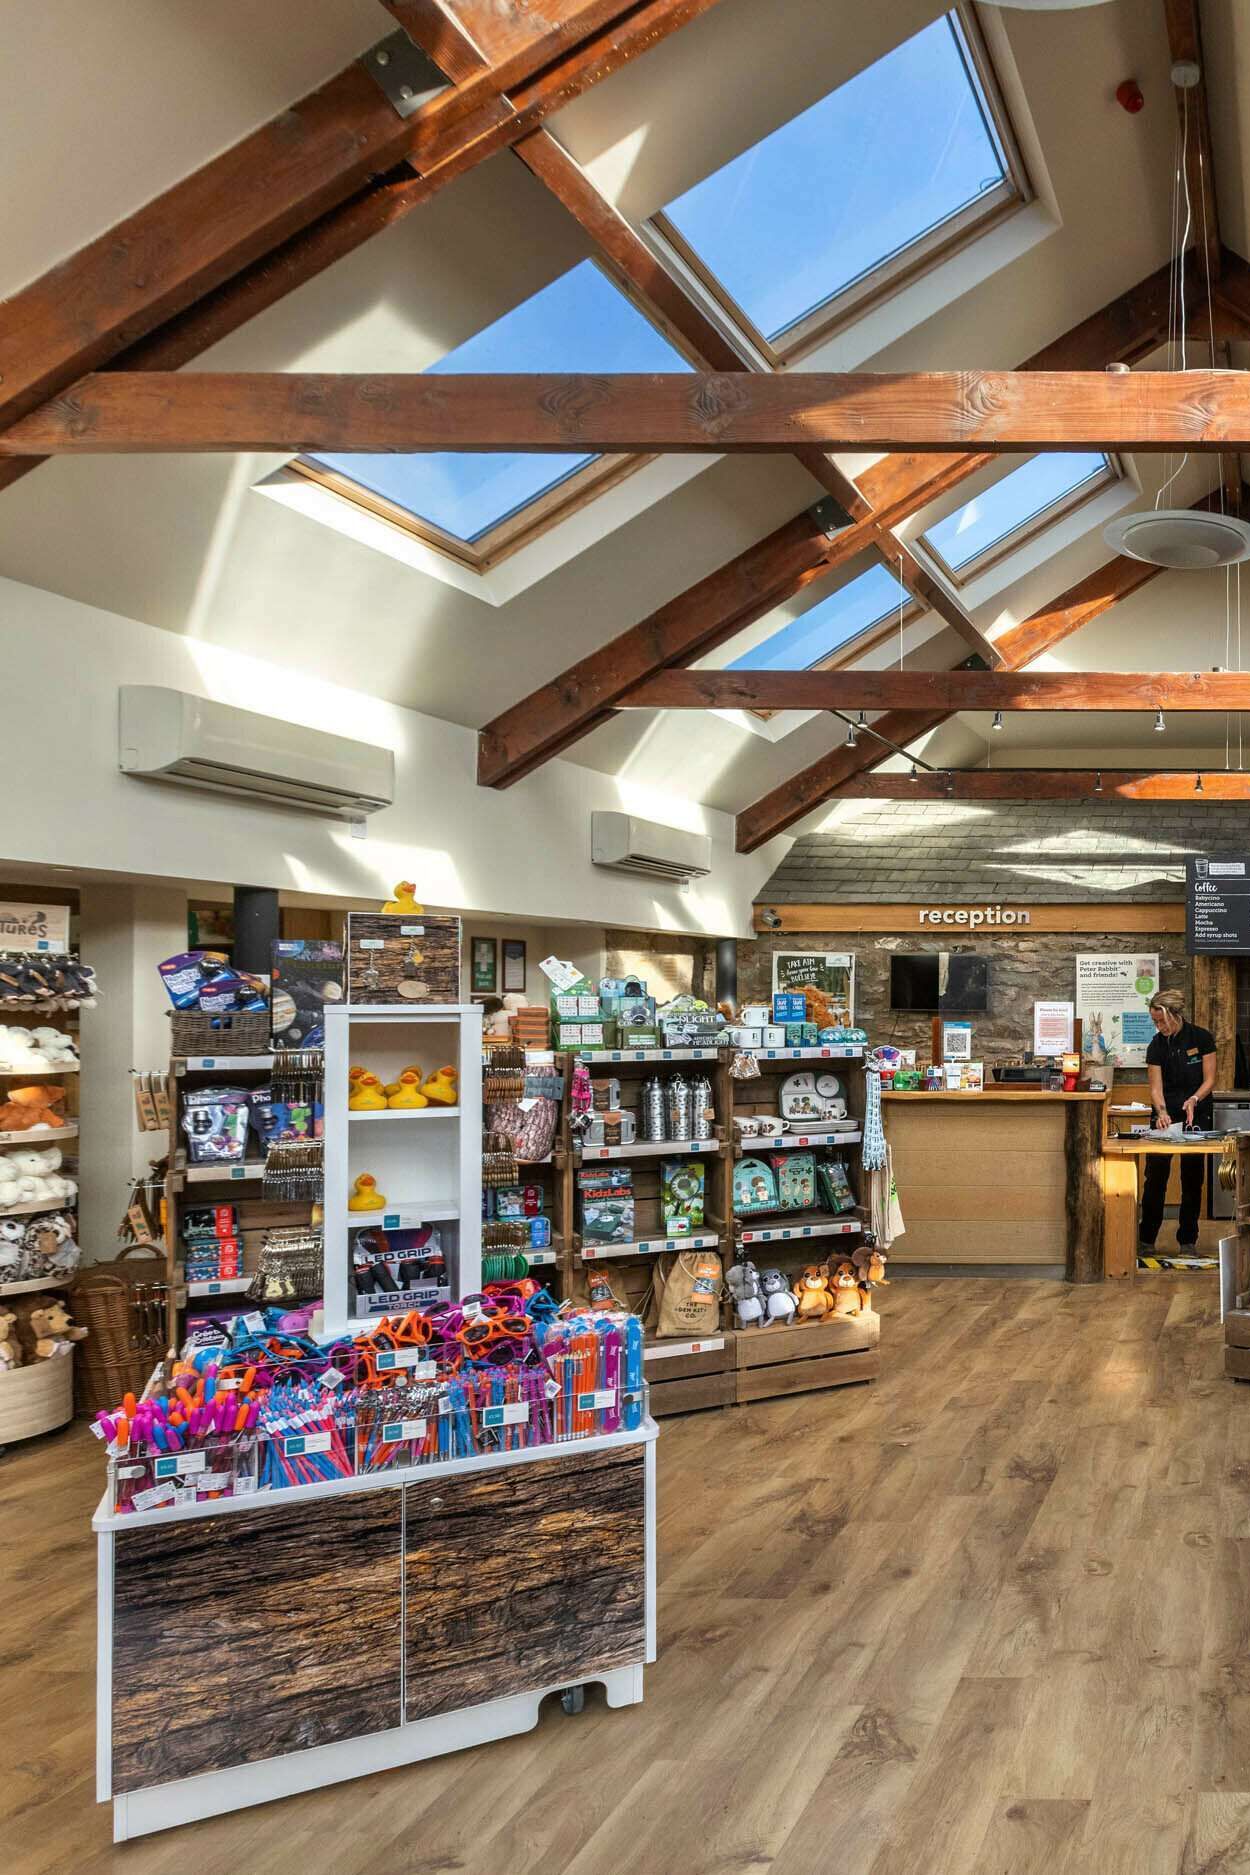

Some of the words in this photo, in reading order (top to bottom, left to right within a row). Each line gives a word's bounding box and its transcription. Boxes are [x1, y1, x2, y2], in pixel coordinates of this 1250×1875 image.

[1194, 881, 1218, 893] Coffee
[919, 905, 1031, 929] reception
[787, 959, 801, 969] TAKE
[802, 958, 815, 967] AIM
[583, 1187, 632, 1199] KidzLabs
[365, 1253, 395, 1263] LED
[397, 1247, 432, 1259] GRIP
[368, 1294, 400, 1305] LED
[403, 1290, 440, 1301] GRIP
[389, 1301, 420, 1310] TORCH
